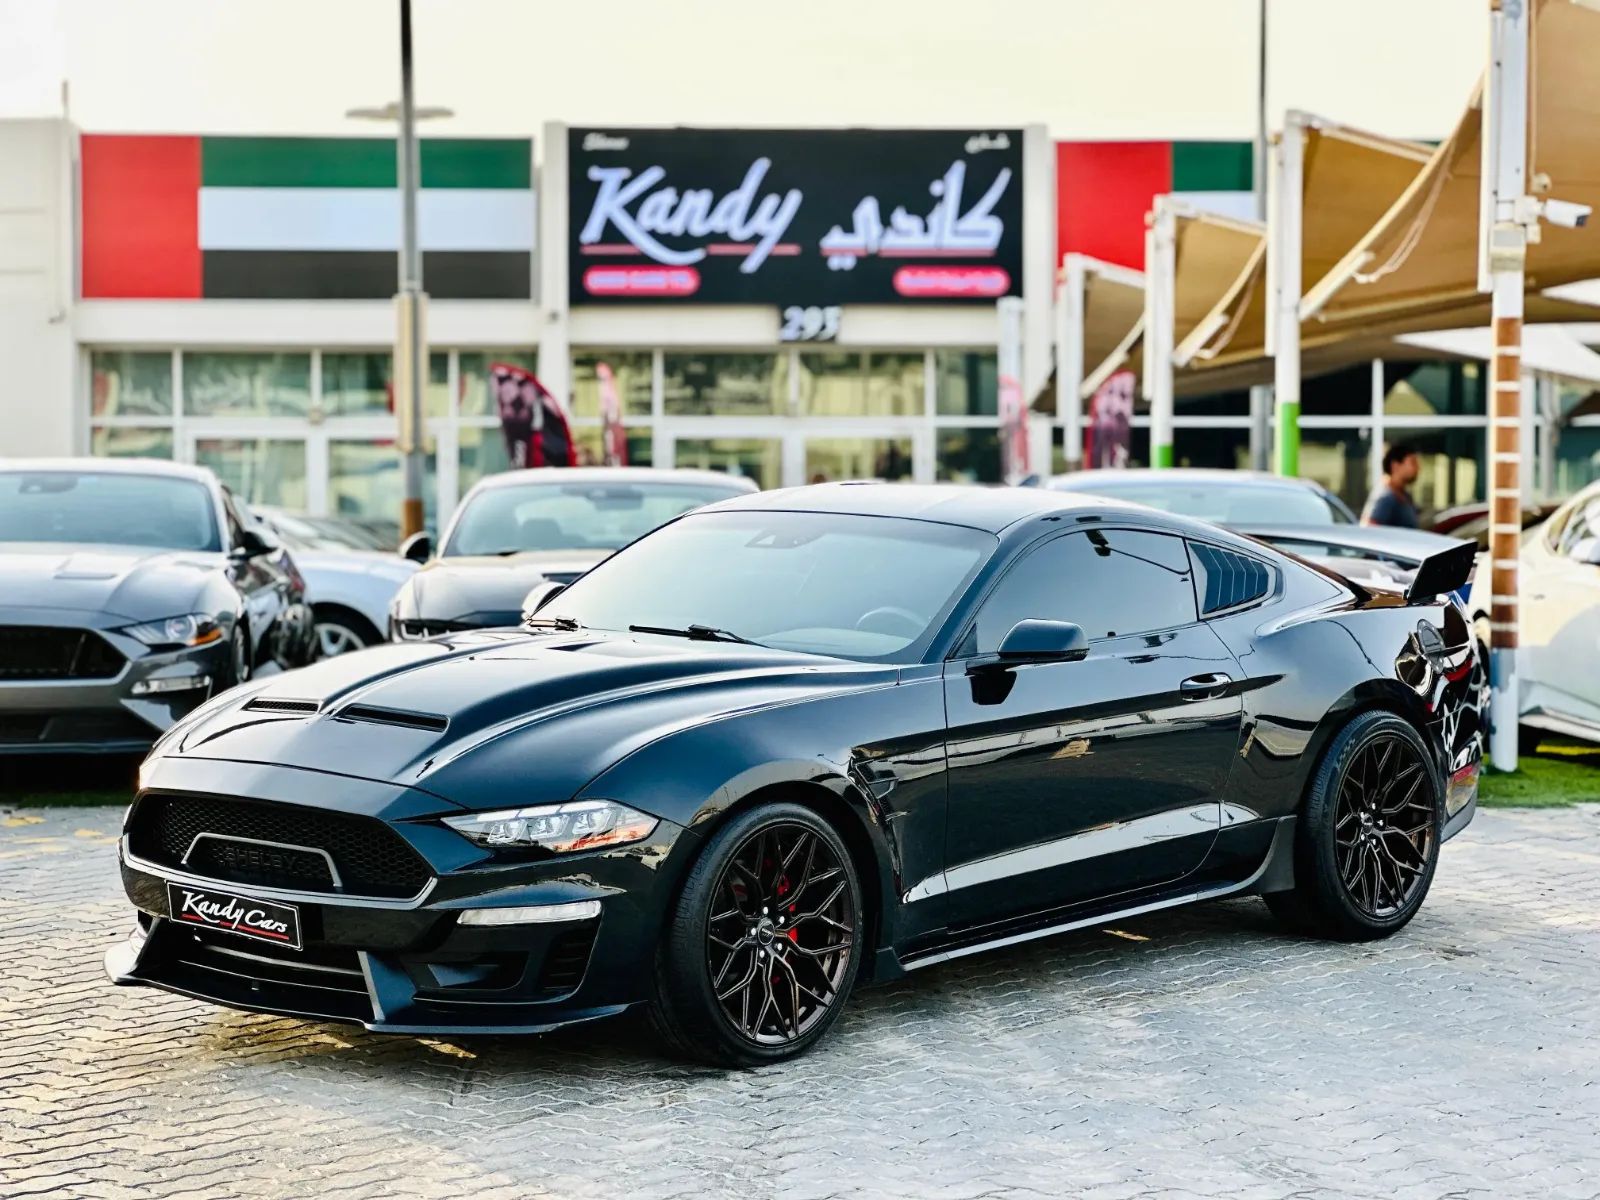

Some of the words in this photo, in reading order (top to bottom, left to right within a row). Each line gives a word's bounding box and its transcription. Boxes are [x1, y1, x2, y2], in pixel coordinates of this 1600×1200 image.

[579, 156, 803, 273] Kandy
[819, 158, 1012, 271] كاندي
[779, 305, 840, 340] 295
[223, 846, 297, 870] SHELBY
[181, 890, 245, 930] Kandy
[244, 909, 288, 933] Cars
